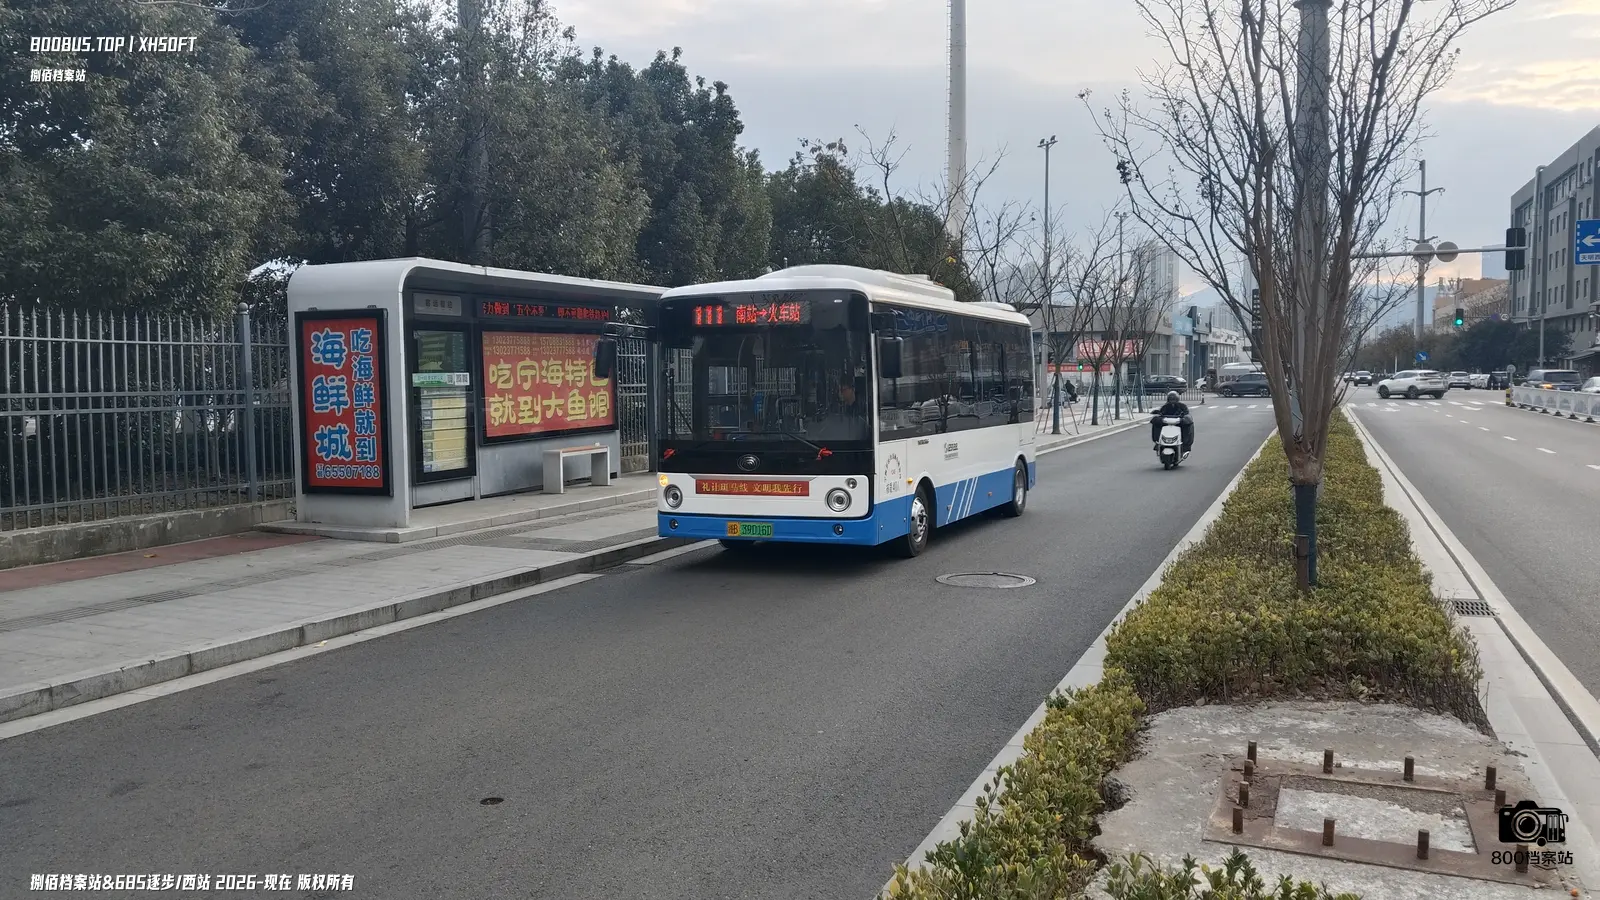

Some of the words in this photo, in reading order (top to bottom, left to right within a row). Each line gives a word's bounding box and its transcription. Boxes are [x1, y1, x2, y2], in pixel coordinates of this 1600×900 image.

[694, 305, 723, 325] 111
[311, 328, 352, 461] 海鲜城
[350, 328, 377, 462] 吃海鲜就到
[489, 388, 610, 427] 就到大鱼馆
[324, 464, 380, 479] 65507188
